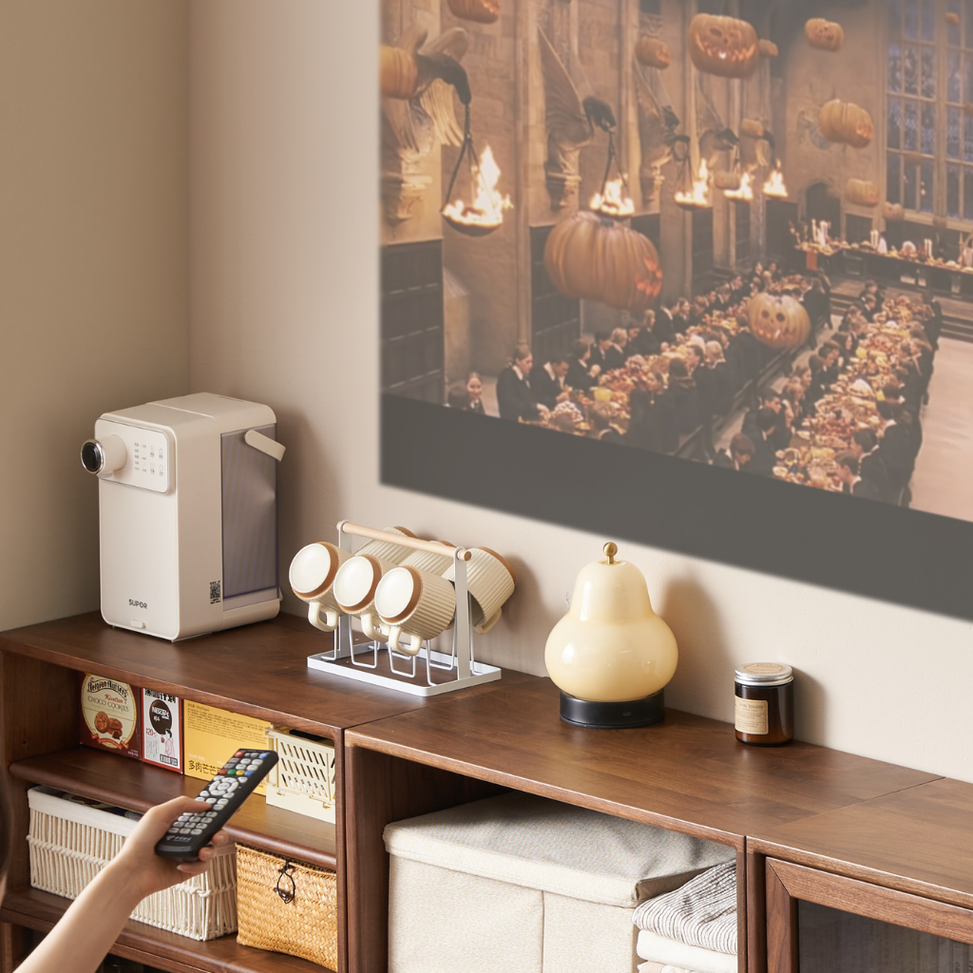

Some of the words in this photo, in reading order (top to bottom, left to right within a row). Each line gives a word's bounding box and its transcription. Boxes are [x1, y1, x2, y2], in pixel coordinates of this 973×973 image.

[128, 598, 148, 610] SUPOR
[87, 695, 106, 706] CHOCO
[107, 701, 129, 712] COOKIES
